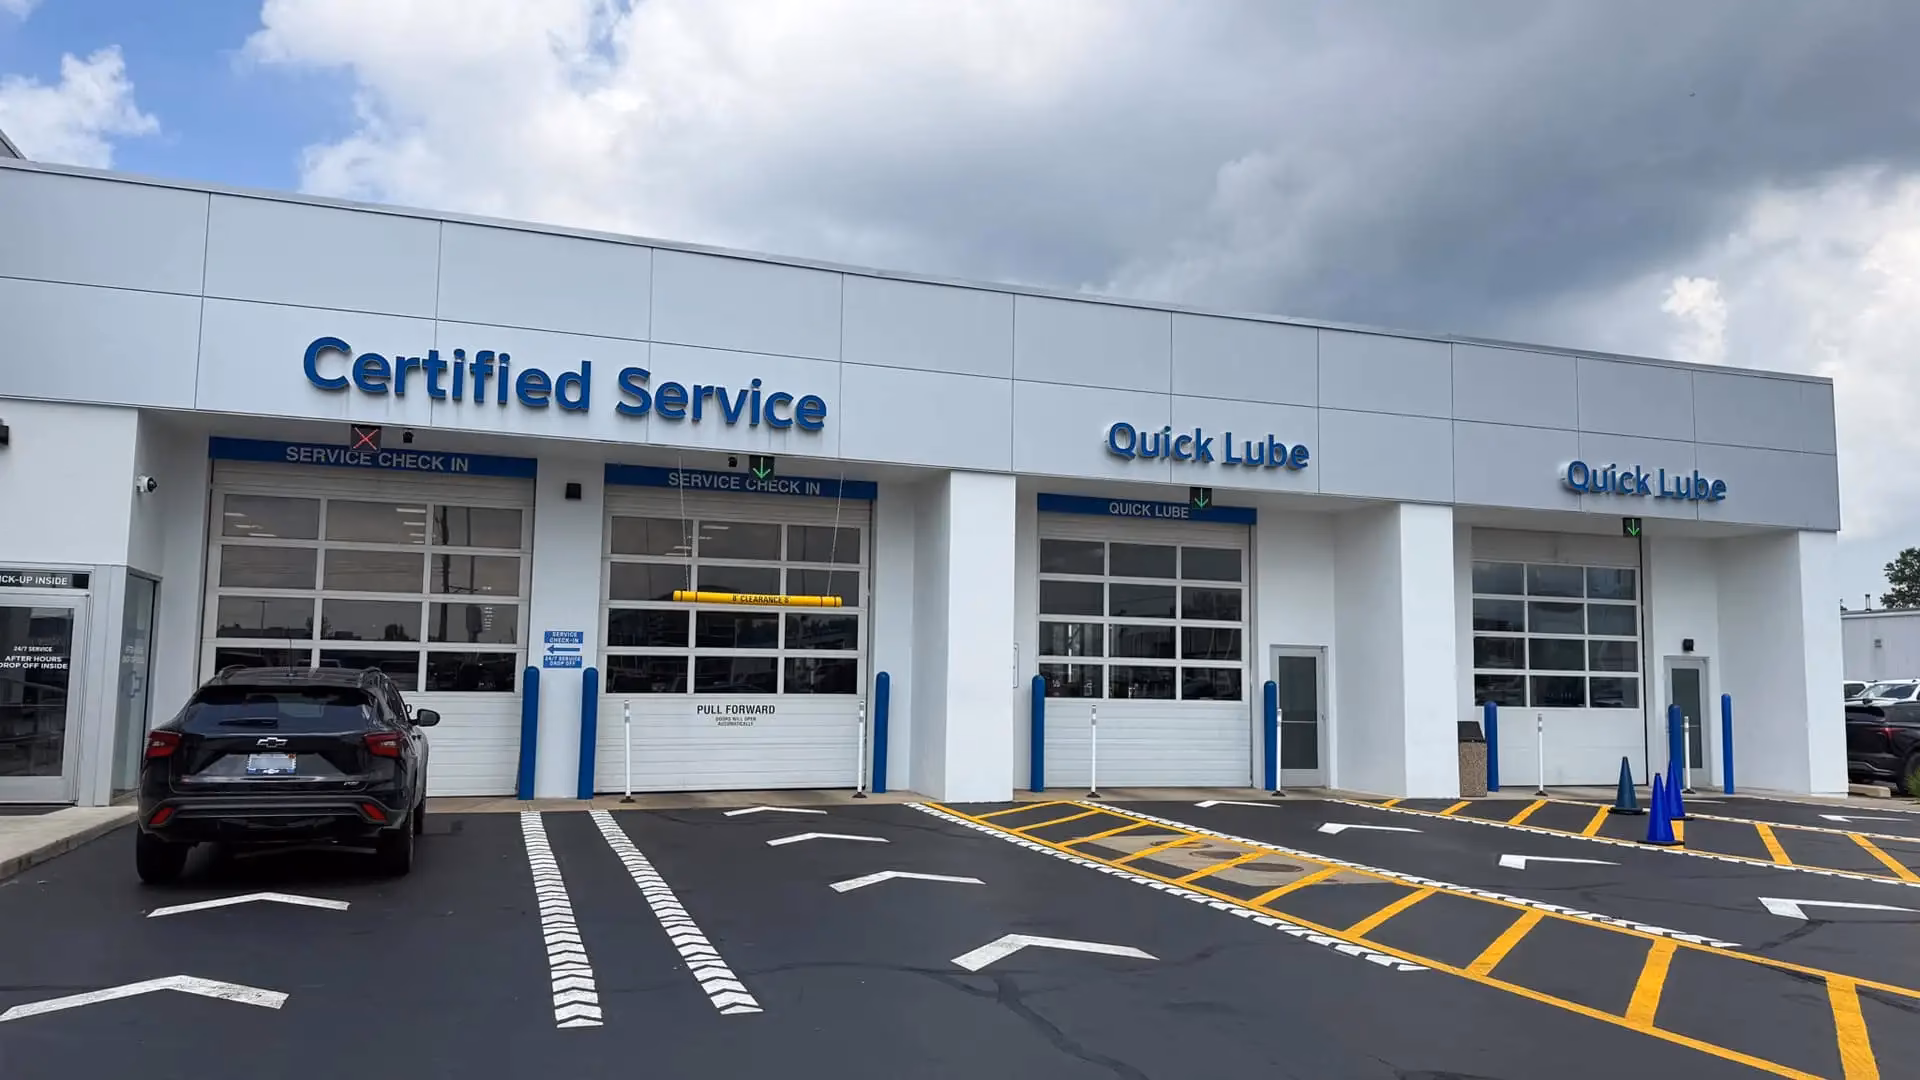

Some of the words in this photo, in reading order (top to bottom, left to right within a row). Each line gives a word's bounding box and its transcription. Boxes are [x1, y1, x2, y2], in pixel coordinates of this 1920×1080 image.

[303, 336, 592, 411] Certified
[615, 366, 827, 431] Service
[1106, 422, 1215, 461] Quick
[1222, 431, 1310, 469] Lube
[286, 446, 372, 466] SERVICE
[378, 452, 444, 470] CHECK
[451, 458, 469, 472] IN
[668, 472, 740, 489] SERVICE
[745, 478, 800, 494] CHECK
[805, 482, 821, 495] IN
[1566, 460, 1651, 496] Quick
[1654, 468, 1727, 501] Lube
[1109, 502, 1151, 517] QUICK
[1155, 504, 1189, 519] LUBE
[0, 575, 33, 584] ICK-UP
[35, 576, 68, 585] INSIDE
[740, 595, 782, 604] CLEARANCE
[697, 704, 722, 715] PULL
[725, 704, 776, 715] FORWARD
